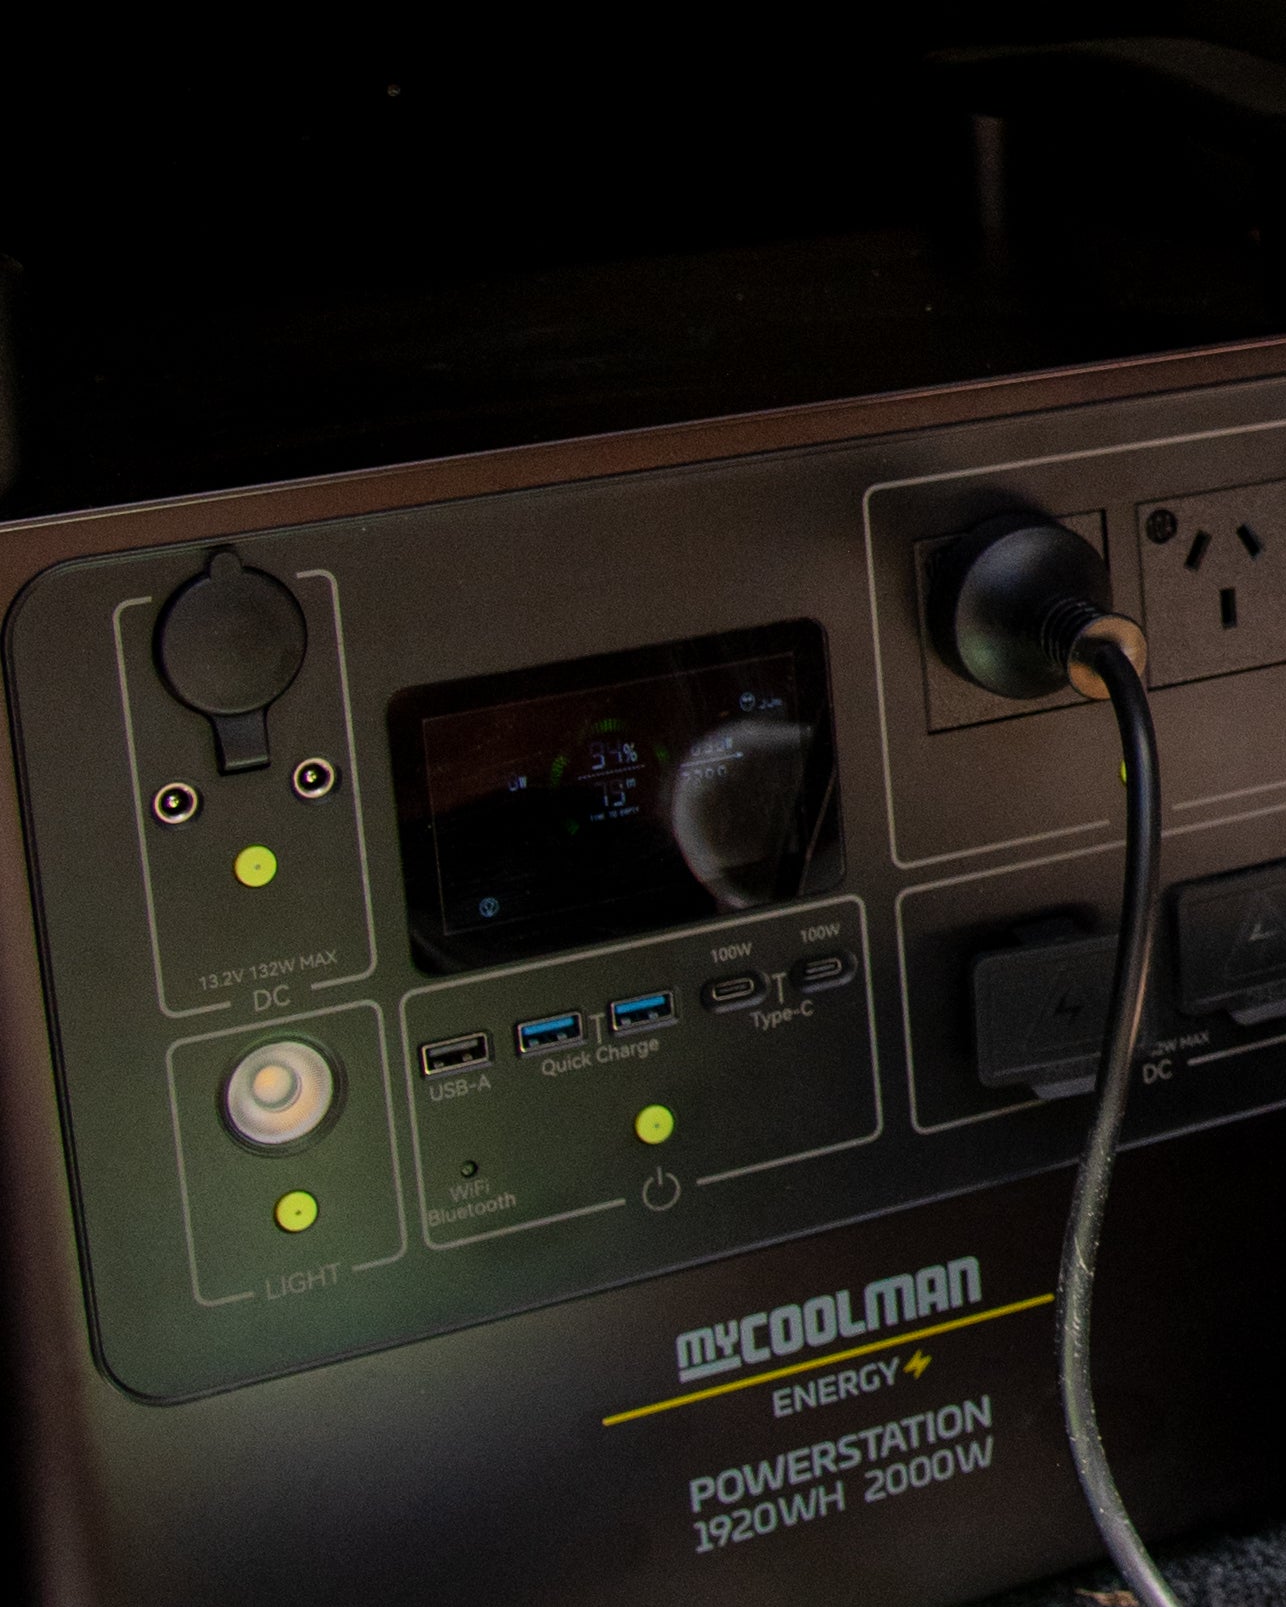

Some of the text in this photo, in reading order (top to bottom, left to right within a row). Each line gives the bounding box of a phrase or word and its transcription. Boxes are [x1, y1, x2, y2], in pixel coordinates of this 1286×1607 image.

[800, 922, 841, 944] 100W
[249, 959, 296, 980] 132W
[300, 949, 338, 970] MAX
[710, 941, 753, 964] 100W
[253, 984, 291, 1012] DC
[748, 999, 815, 1031] Type-C
[540, 1037, 660, 1077] Quick Charge
[1142, 1059, 1173, 1085] DC
[429, 1074, 492, 1102] USB-A
[450, 1178, 490, 1203] WiFi
[427, 1192, 517, 1228] Bluetooth
[264, 1262, 340, 1300] LIGHT
[772, 1356, 900, 1419] ENERGY
[689, 1394, 993, 1514] POWERSTATION
[694, 1435, 995, 1554] 1920WH 2000W
